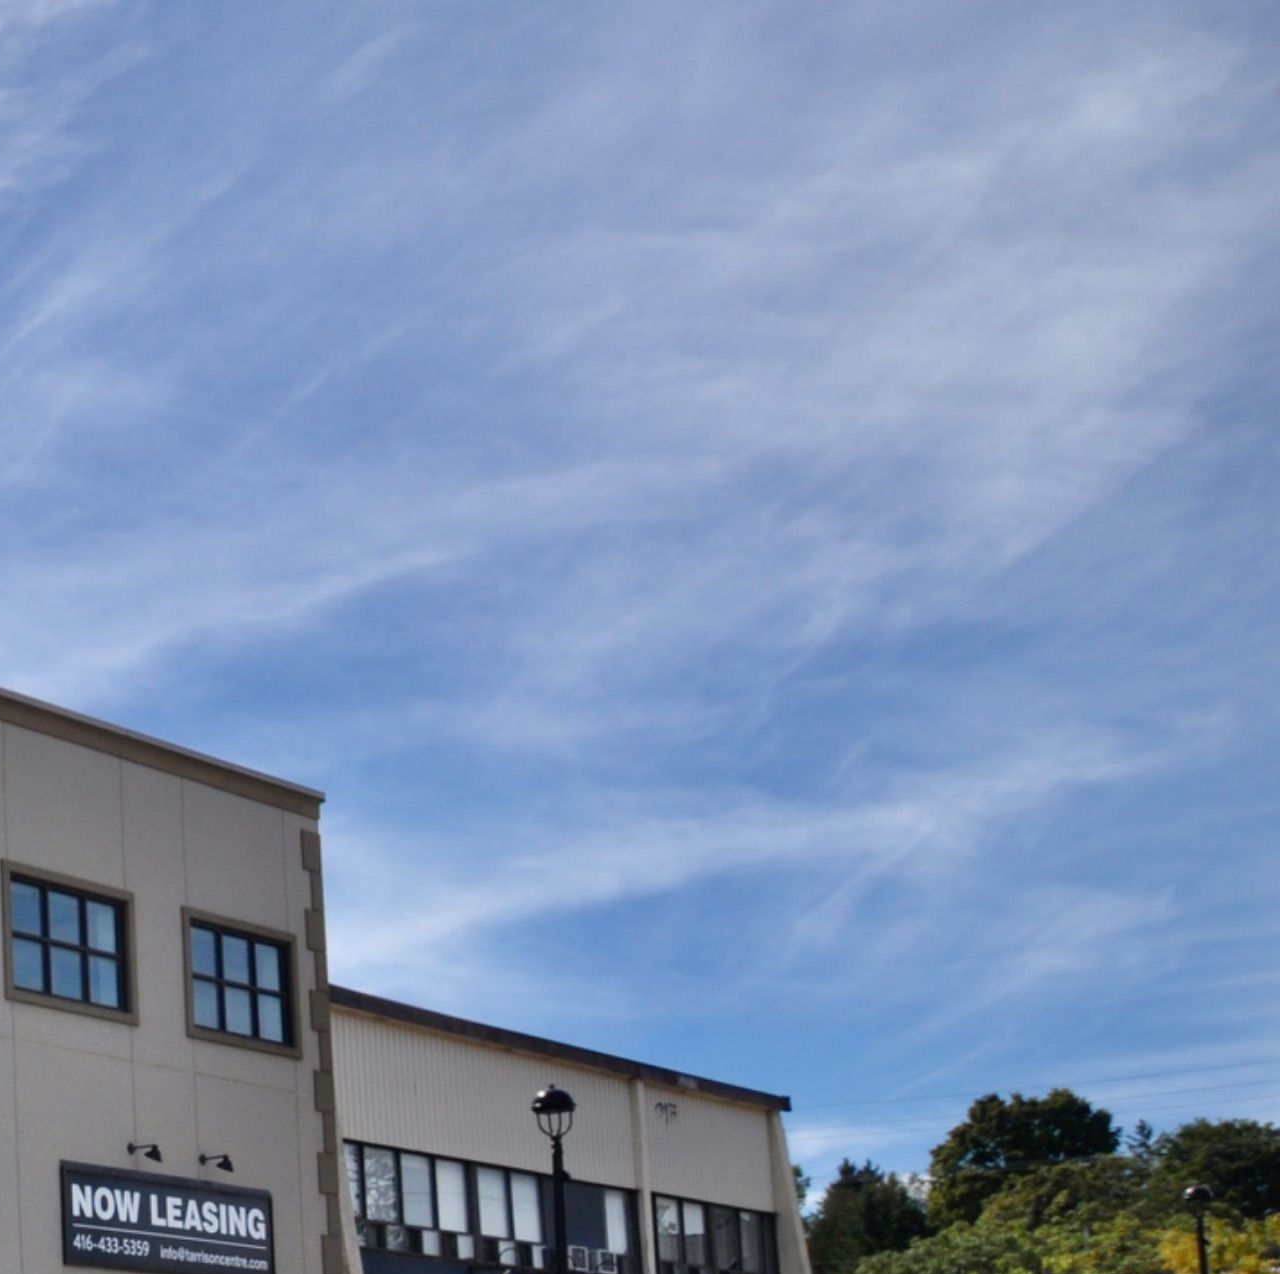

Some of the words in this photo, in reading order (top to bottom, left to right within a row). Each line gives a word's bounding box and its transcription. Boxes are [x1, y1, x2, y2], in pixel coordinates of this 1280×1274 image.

[71, 1183, 140, 1223] NOW
[149, 1194, 267, 1240] LEASING
[72, 1233, 150, 1256] 416-433-5359
